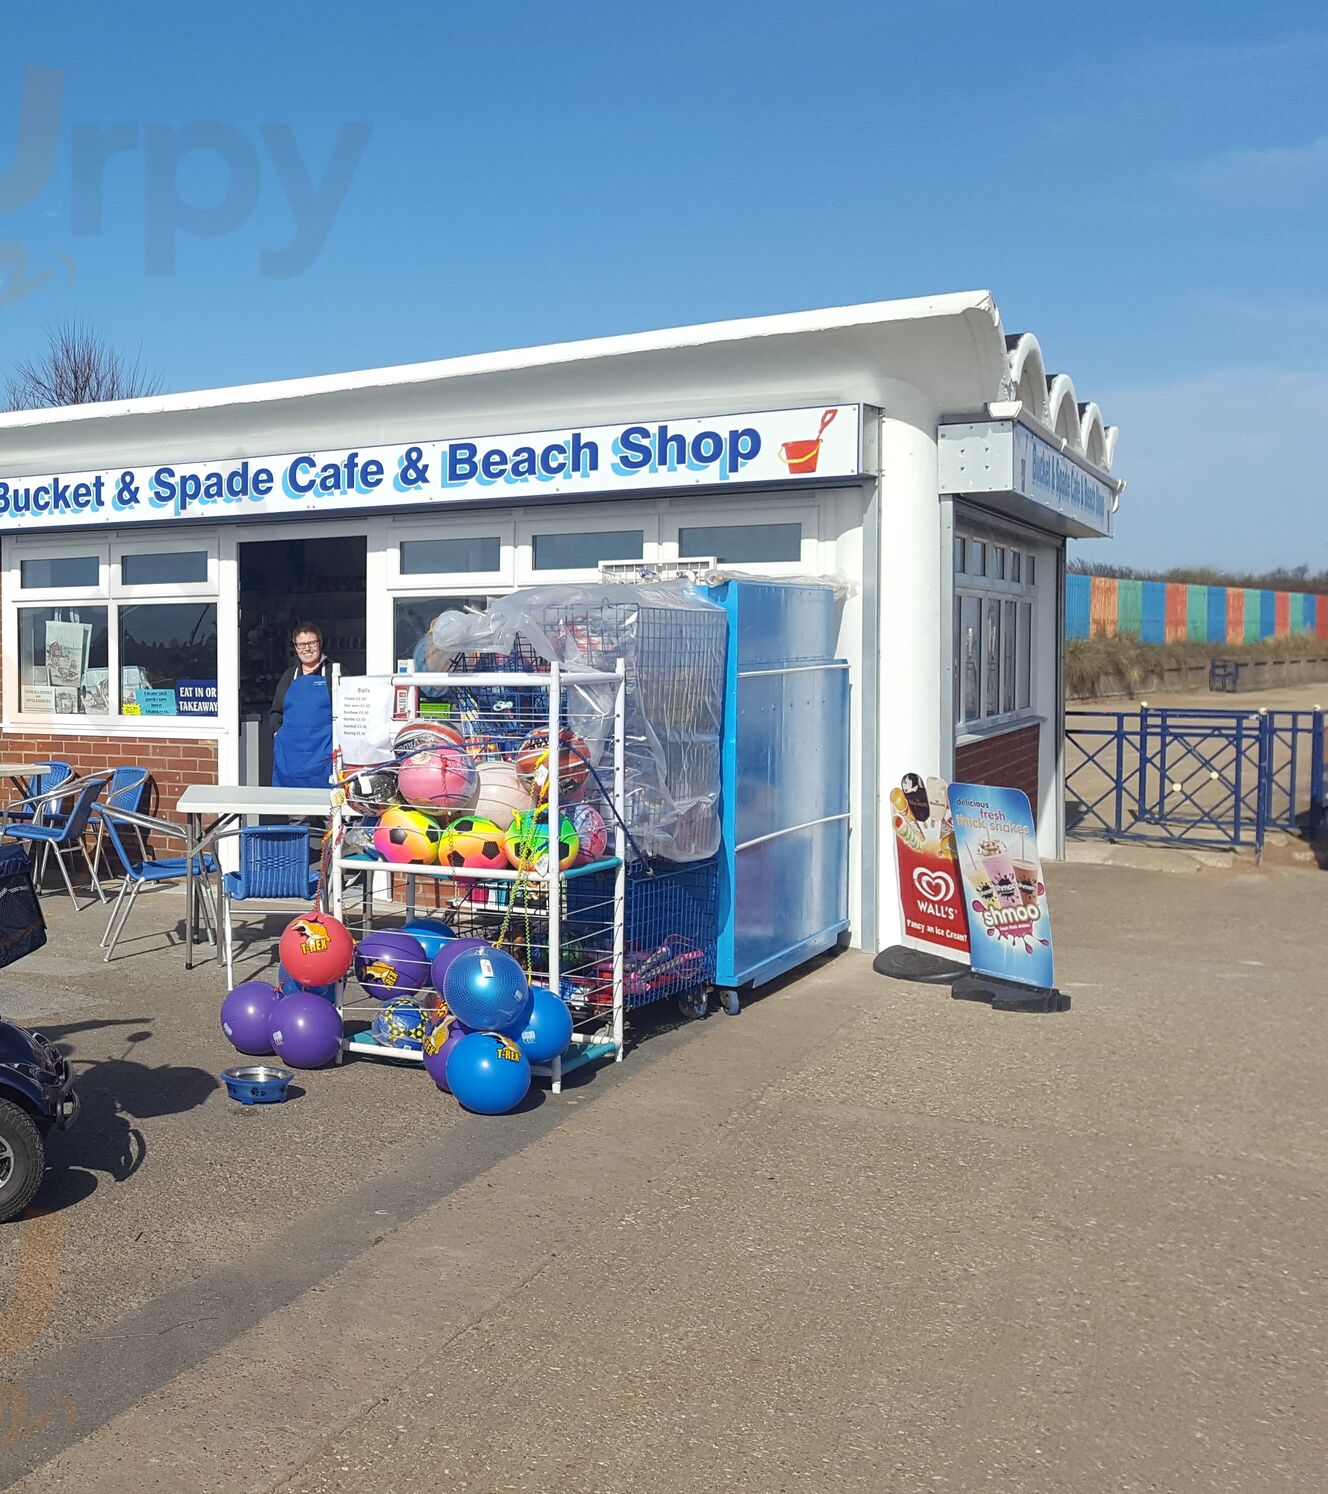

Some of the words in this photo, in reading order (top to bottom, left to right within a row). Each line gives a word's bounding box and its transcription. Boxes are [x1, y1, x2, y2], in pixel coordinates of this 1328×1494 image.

[115, 470, 141, 507] &
[152, 461, 273, 511] Spade
[286, 451, 385, 494] Cafe
[399, 445, 430, 488] &
[447, 432, 600, 483] Beach
[618, 424, 762, 474] Shop
[179, 687, 194, 697] EAT
[195, 687, 204, 697] IN
[205, 688, 217, 698] OR
[179, 701, 218, 712] TAKEAWAY
[956, 798, 989, 808] delicious
[980, 809, 1006, 821] fresh
[957, 814, 985, 829] thick
[989, 820, 1029, 836] shakes
[917, 900, 955, 920] WALL'S
[983, 904, 1040, 927] shmoo
[906, 919, 926, 934] Fancy
[926, 925, 935, 933] an
[935, 926, 944, 936] Ice
[300, 938, 327, 954] T-REX
